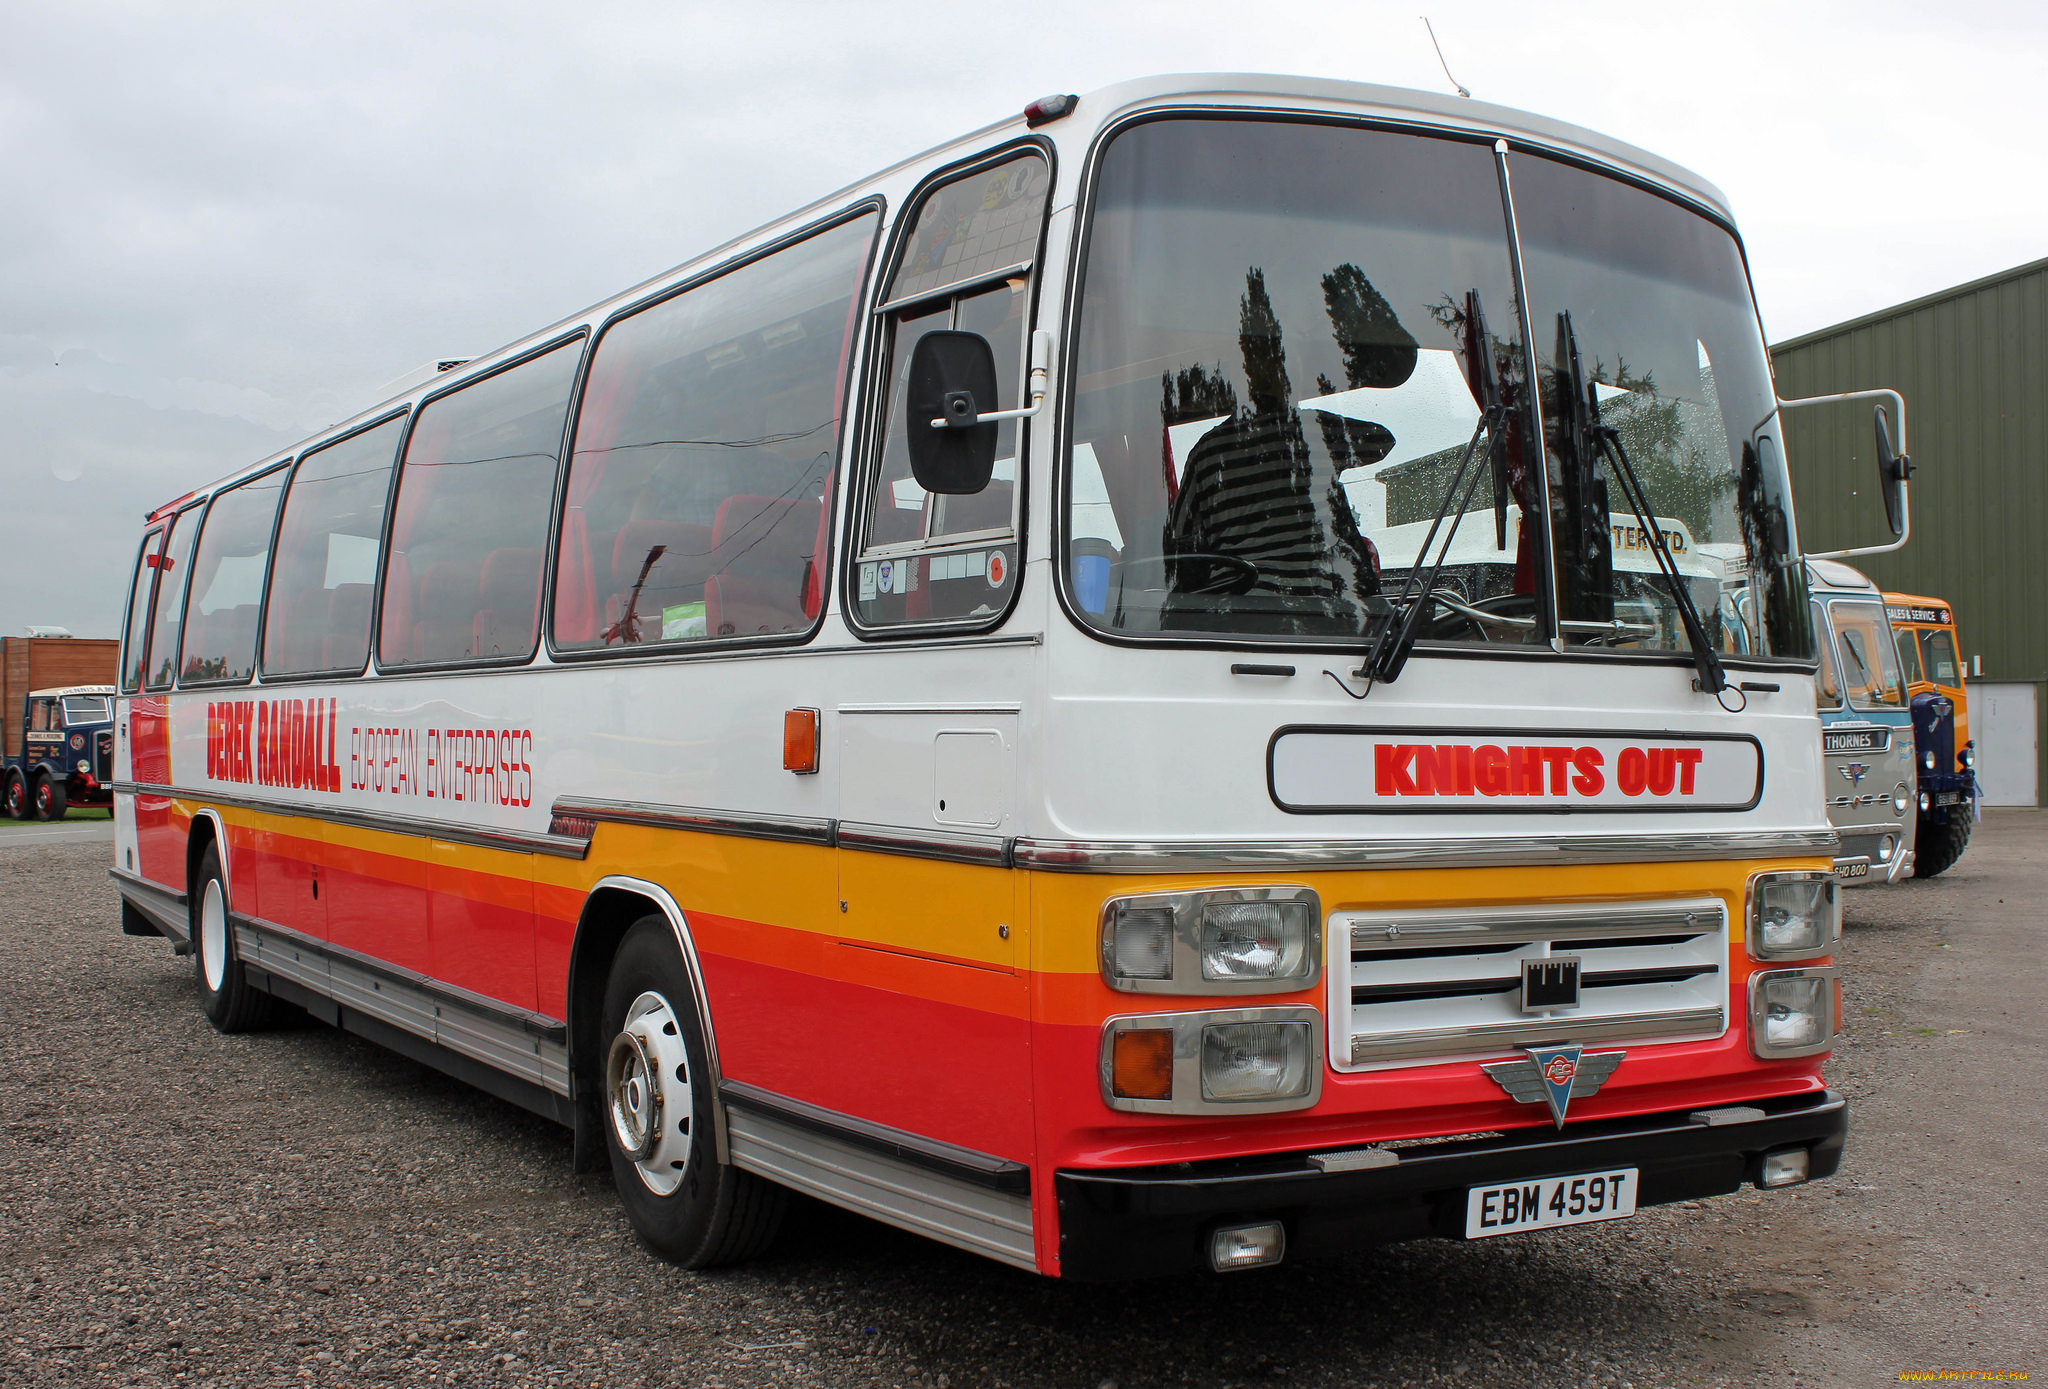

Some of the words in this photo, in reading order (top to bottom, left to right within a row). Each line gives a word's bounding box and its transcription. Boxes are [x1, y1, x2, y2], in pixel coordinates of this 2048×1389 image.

[1912, 610, 1937, 621] SERVICE
[207, 701, 254, 784] DEREK
[257, 697, 341, 793] RANDALL
[352, 728, 419, 796] EUROPEAN
[427, 729, 532, 808] ENTERPRISES
[1825, 734, 1871, 749] THORNES
[1374, 744, 1605, 797] KNIGHTS
[1617, 747, 1703, 797] OUT
[1547, 1063, 1572, 1077] AEC
[1480, 1185, 1541, 1228] EBM
[1549, 1175, 1625, 1217] 459T
